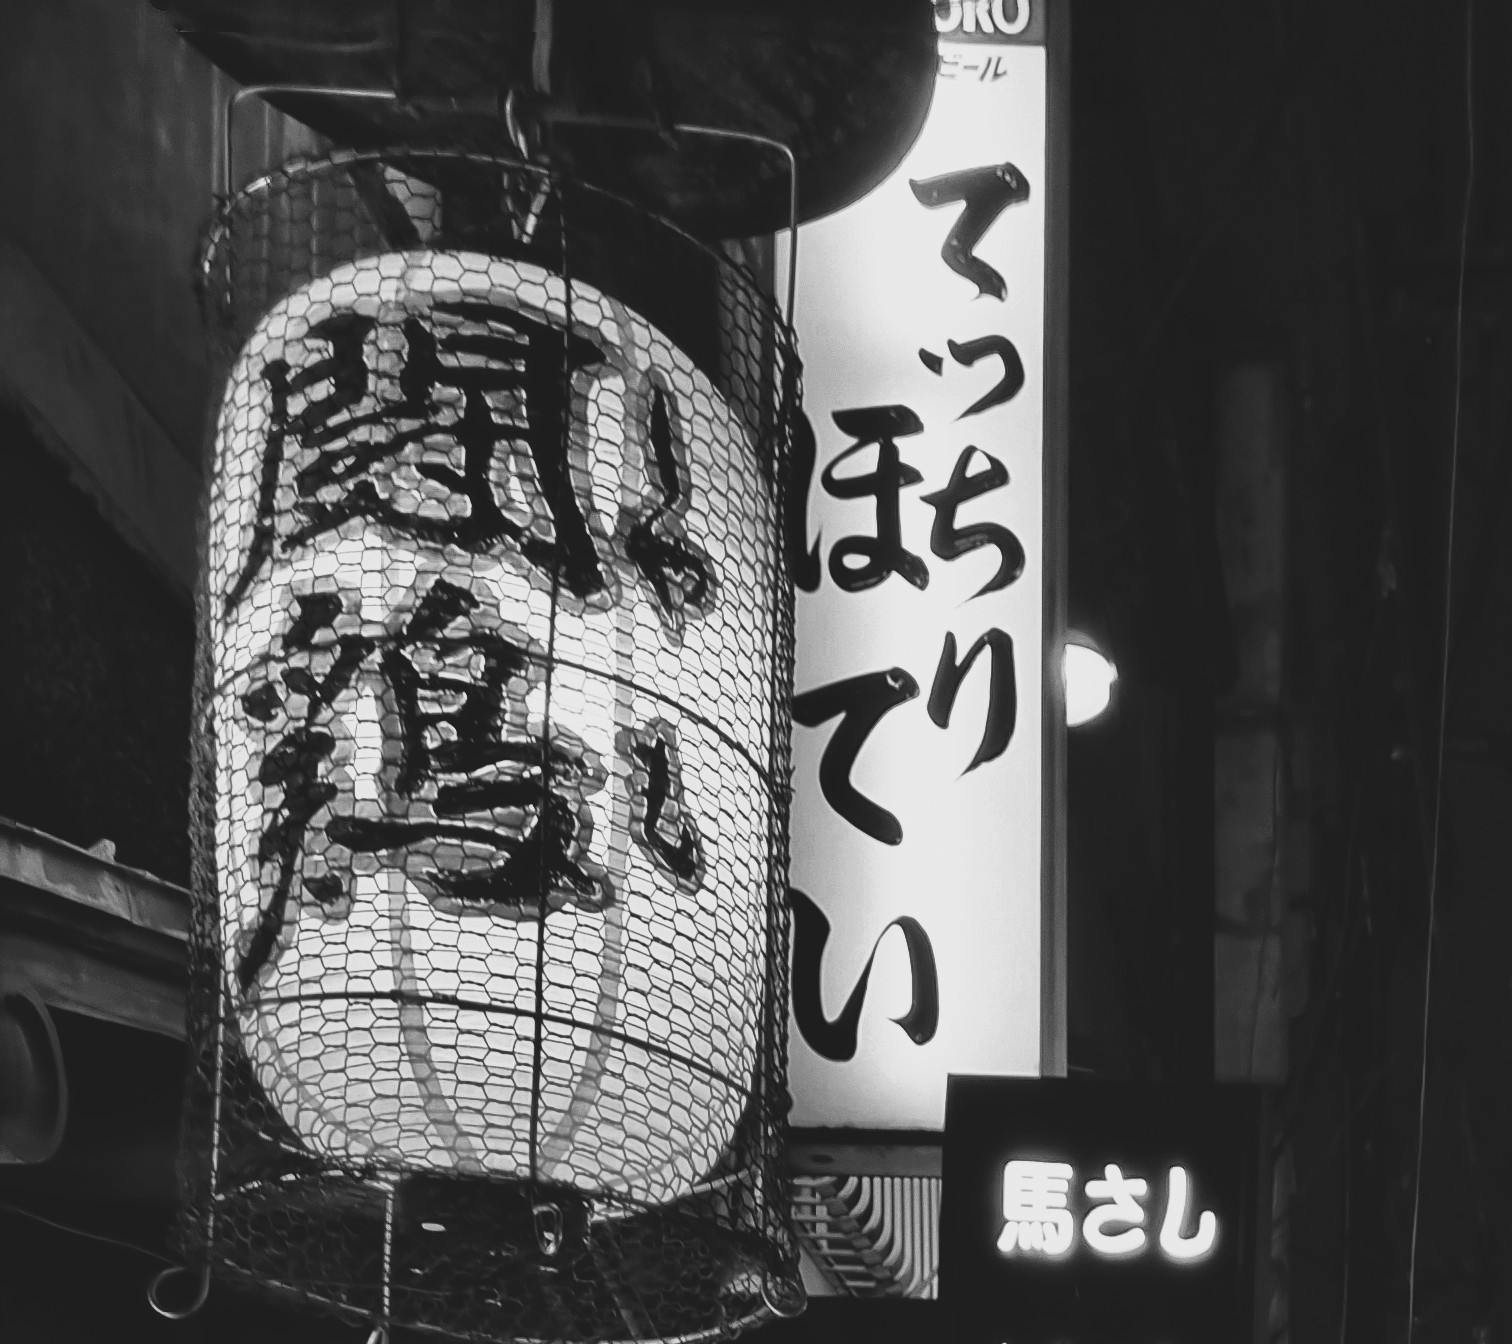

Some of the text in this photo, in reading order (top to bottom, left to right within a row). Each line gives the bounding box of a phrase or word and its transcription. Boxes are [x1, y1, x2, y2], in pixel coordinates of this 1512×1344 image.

[793, 404, 939, 1062] ほてい
[997, 1160, 1218, 1260] 馬さし
